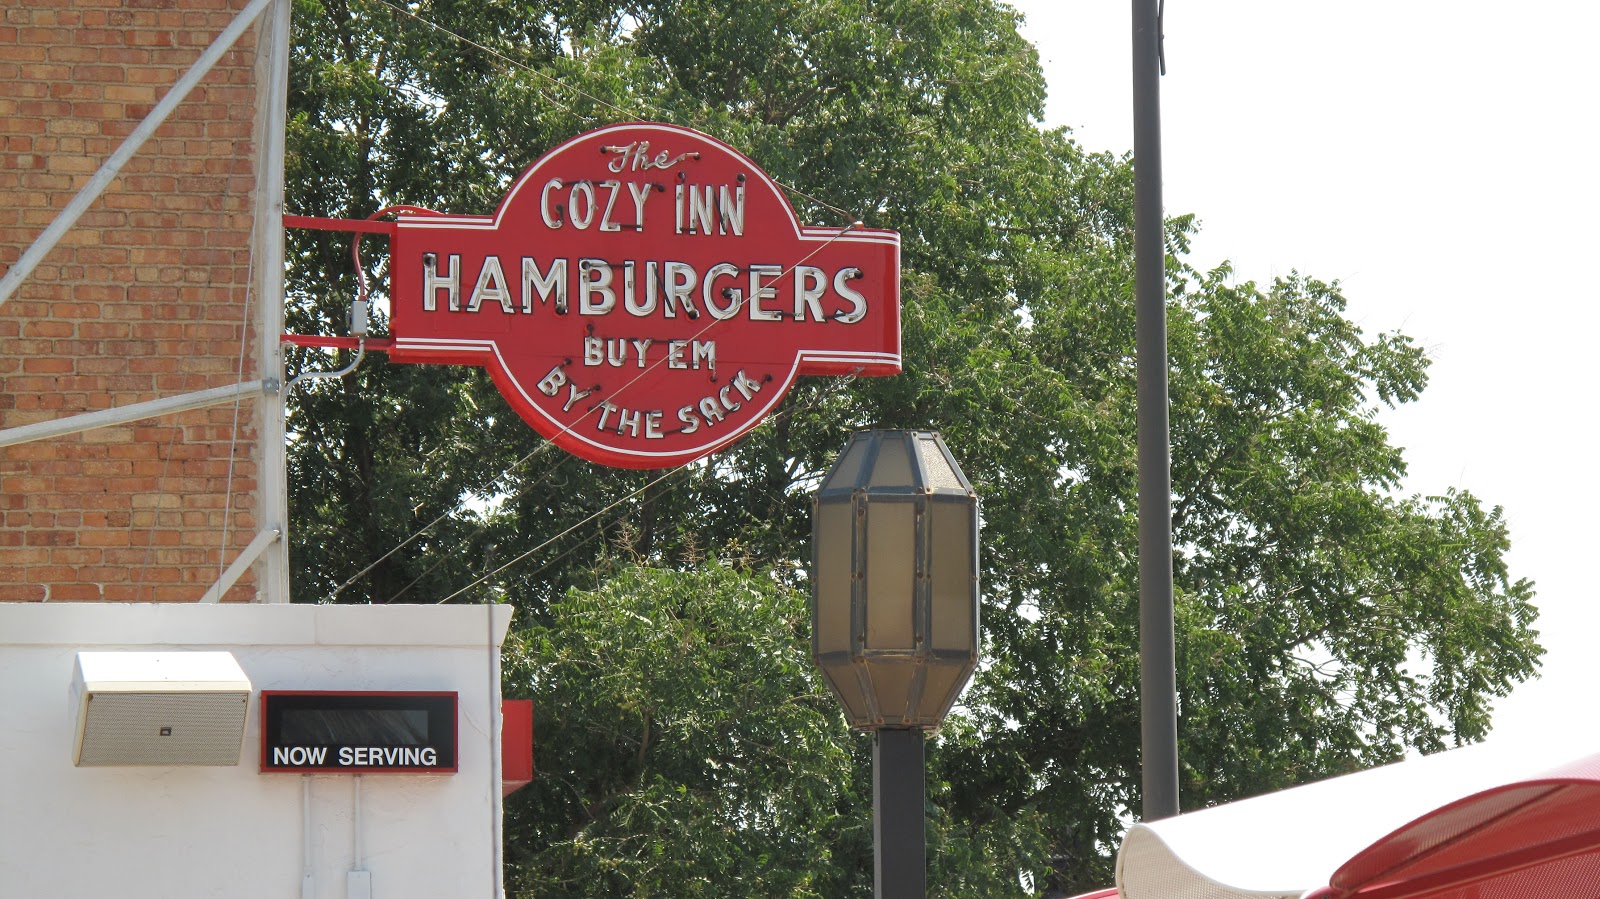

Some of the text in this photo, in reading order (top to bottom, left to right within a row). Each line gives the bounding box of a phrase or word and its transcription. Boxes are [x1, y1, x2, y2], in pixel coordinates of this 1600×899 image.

[605, 140, 690, 173] The
[539, 177, 746, 237] COZY INN
[422, 252, 869, 324] HAMBURGERS
[583, 334, 717, 371] BUY EM
[536, 365, 763, 439] BY THE SACK
[272, 746, 437, 767] NOW SERVING
